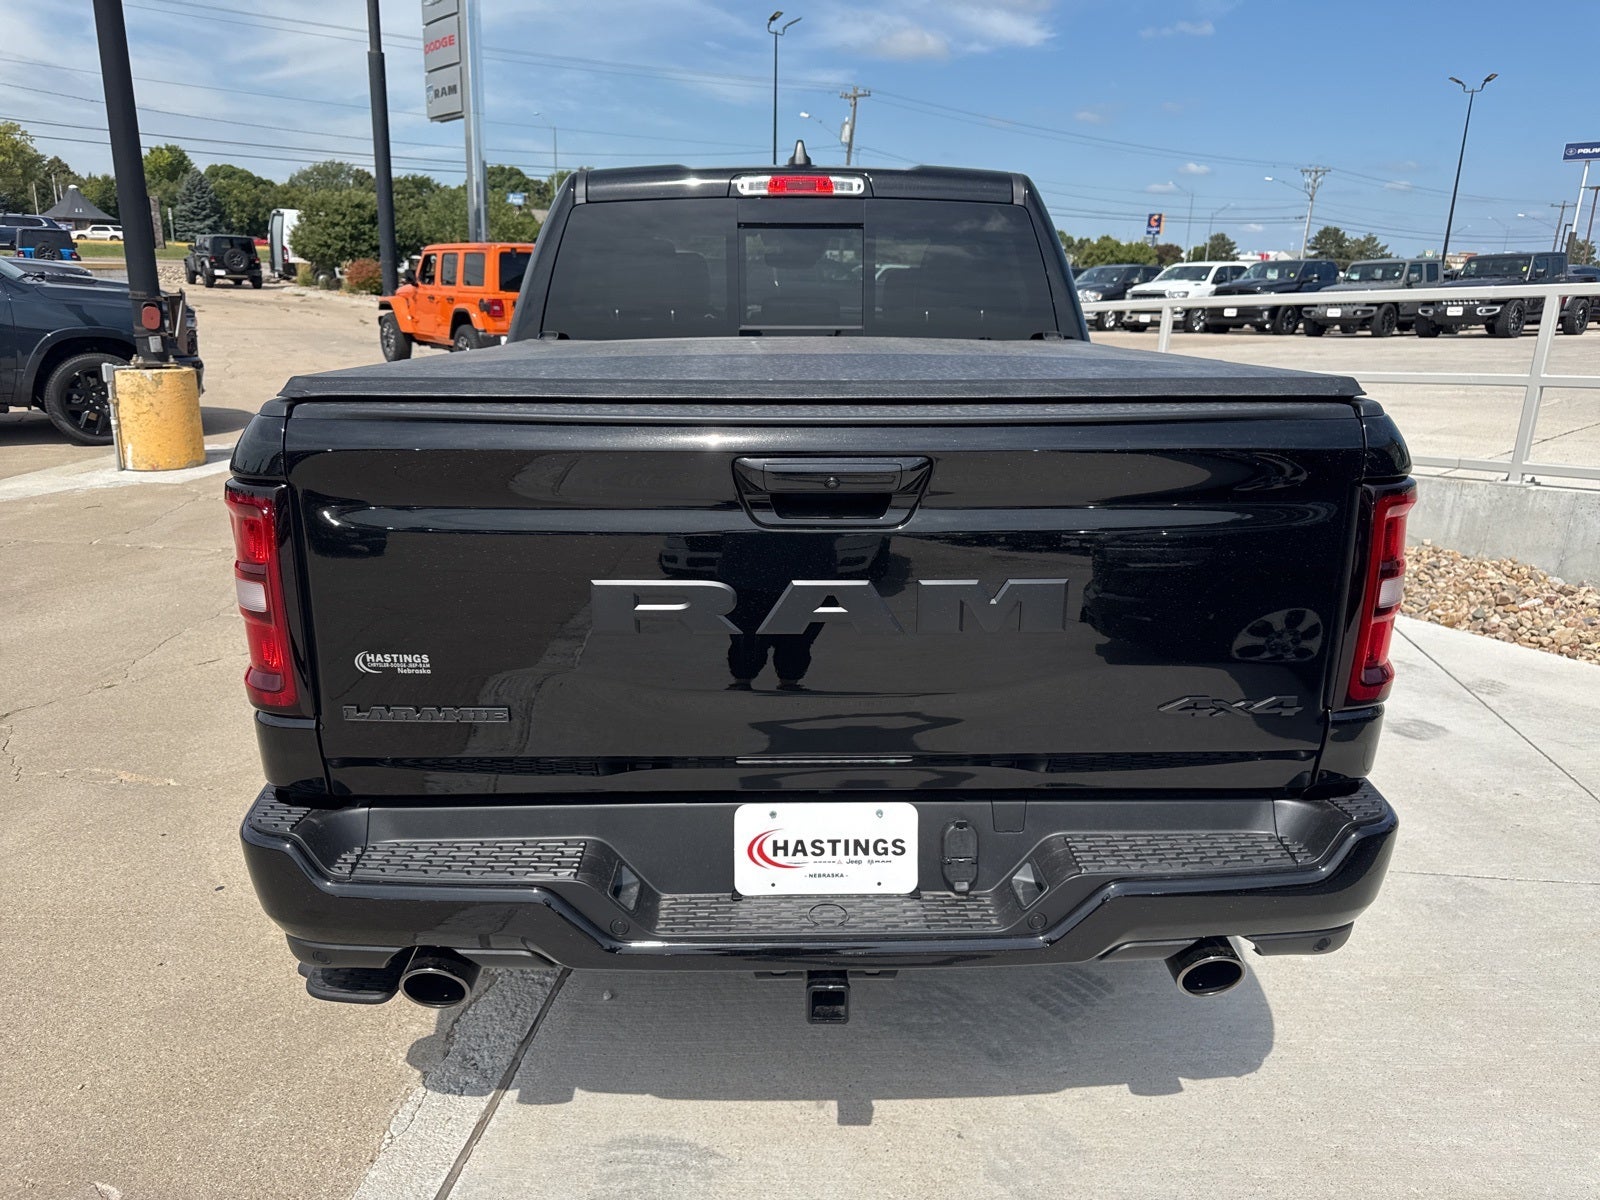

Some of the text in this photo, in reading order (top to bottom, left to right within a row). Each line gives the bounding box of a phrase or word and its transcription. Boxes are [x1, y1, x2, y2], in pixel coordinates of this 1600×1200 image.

[424, 34, 455, 55] DODGE
[434, 84, 457, 99] RAM
[590, 578, 1069, 635] RAM
[366, 653, 430, 663] HASTINGS
[342, 706, 509, 722] LARAMIE
[772, 838, 907, 857] HASTINGS
